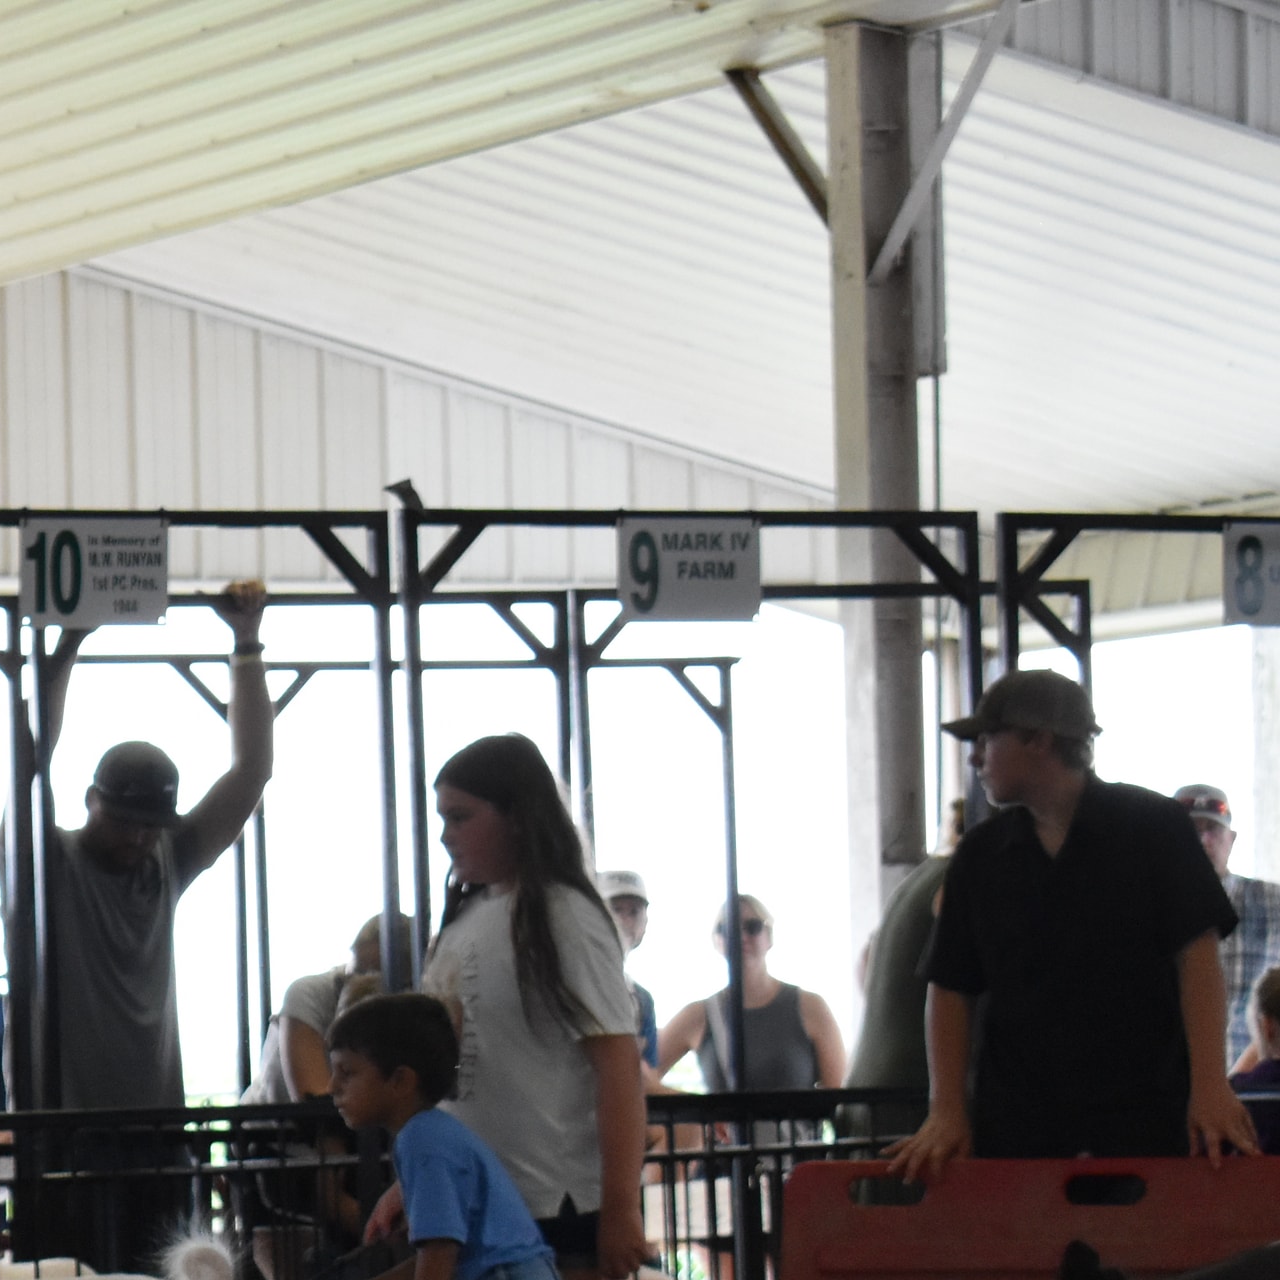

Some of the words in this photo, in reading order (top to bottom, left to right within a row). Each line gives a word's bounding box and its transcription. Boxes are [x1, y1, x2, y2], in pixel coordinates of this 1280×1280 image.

[88, 536, 98, 546] In
[102, 536, 144, 548] Memory
[149, 535, 160, 546] of
[661, 532, 723, 551] MARK
[731, 533, 750, 551] IV
[117, 552, 161, 567] RUNYAN
[25, 530, 82, 615] 10
[630, 531, 659, 613] 9
[677, 561, 734, 580] FARM
[1235, 535, 1264, 616] 8
[112, 576, 126, 591] PC
